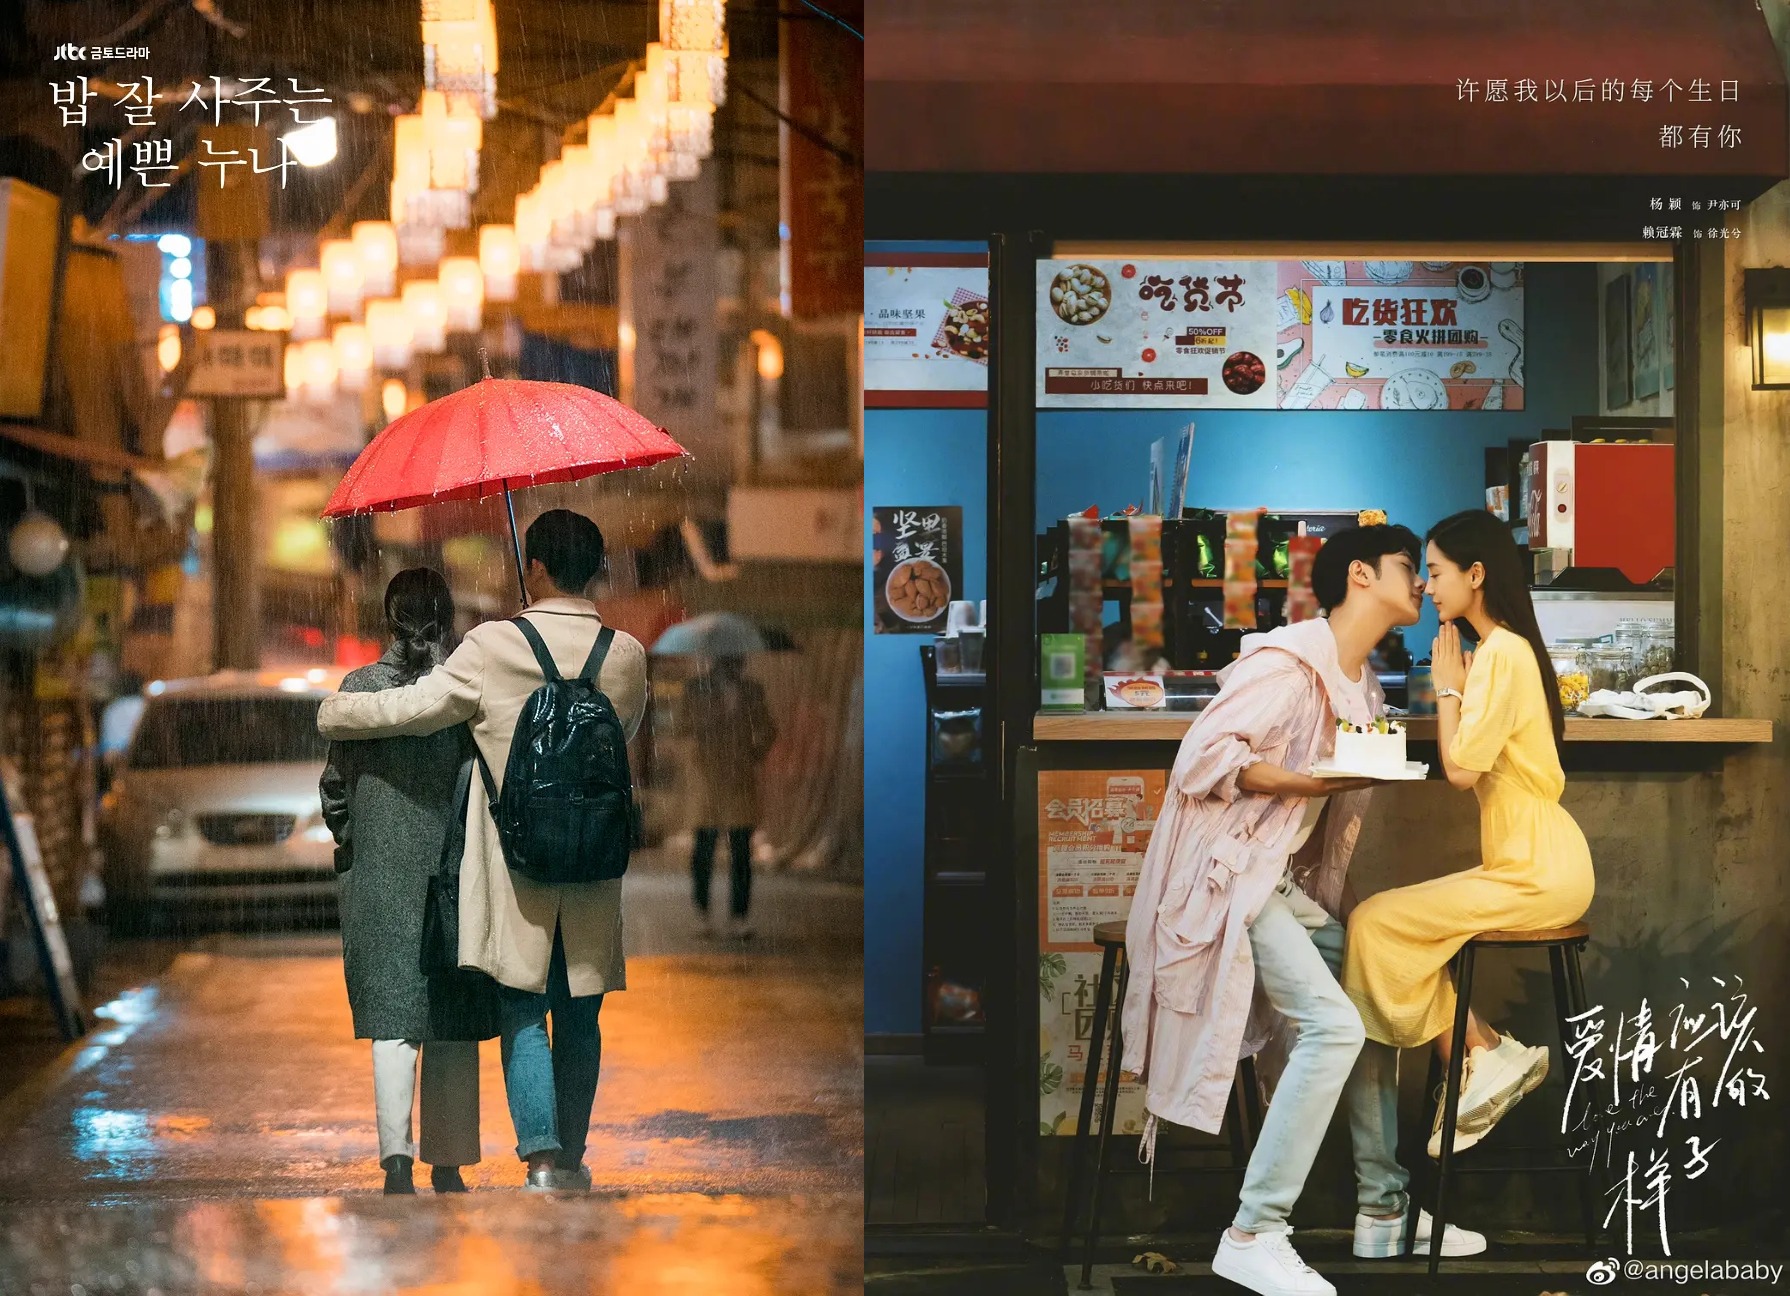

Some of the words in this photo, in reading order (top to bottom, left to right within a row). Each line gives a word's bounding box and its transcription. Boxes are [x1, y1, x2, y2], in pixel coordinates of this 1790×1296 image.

[1138, 274, 1246, 313] 吃货节
[878, 309, 926, 319] 品味坚果
[1342, 298, 1458, 326] 吃货狂欢
[1383, 329, 1479, 345] 零食火拼团购
[1091, 380, 1135, 391] 小吃货们
[1044, 797, 1127, 826] 会员招募
